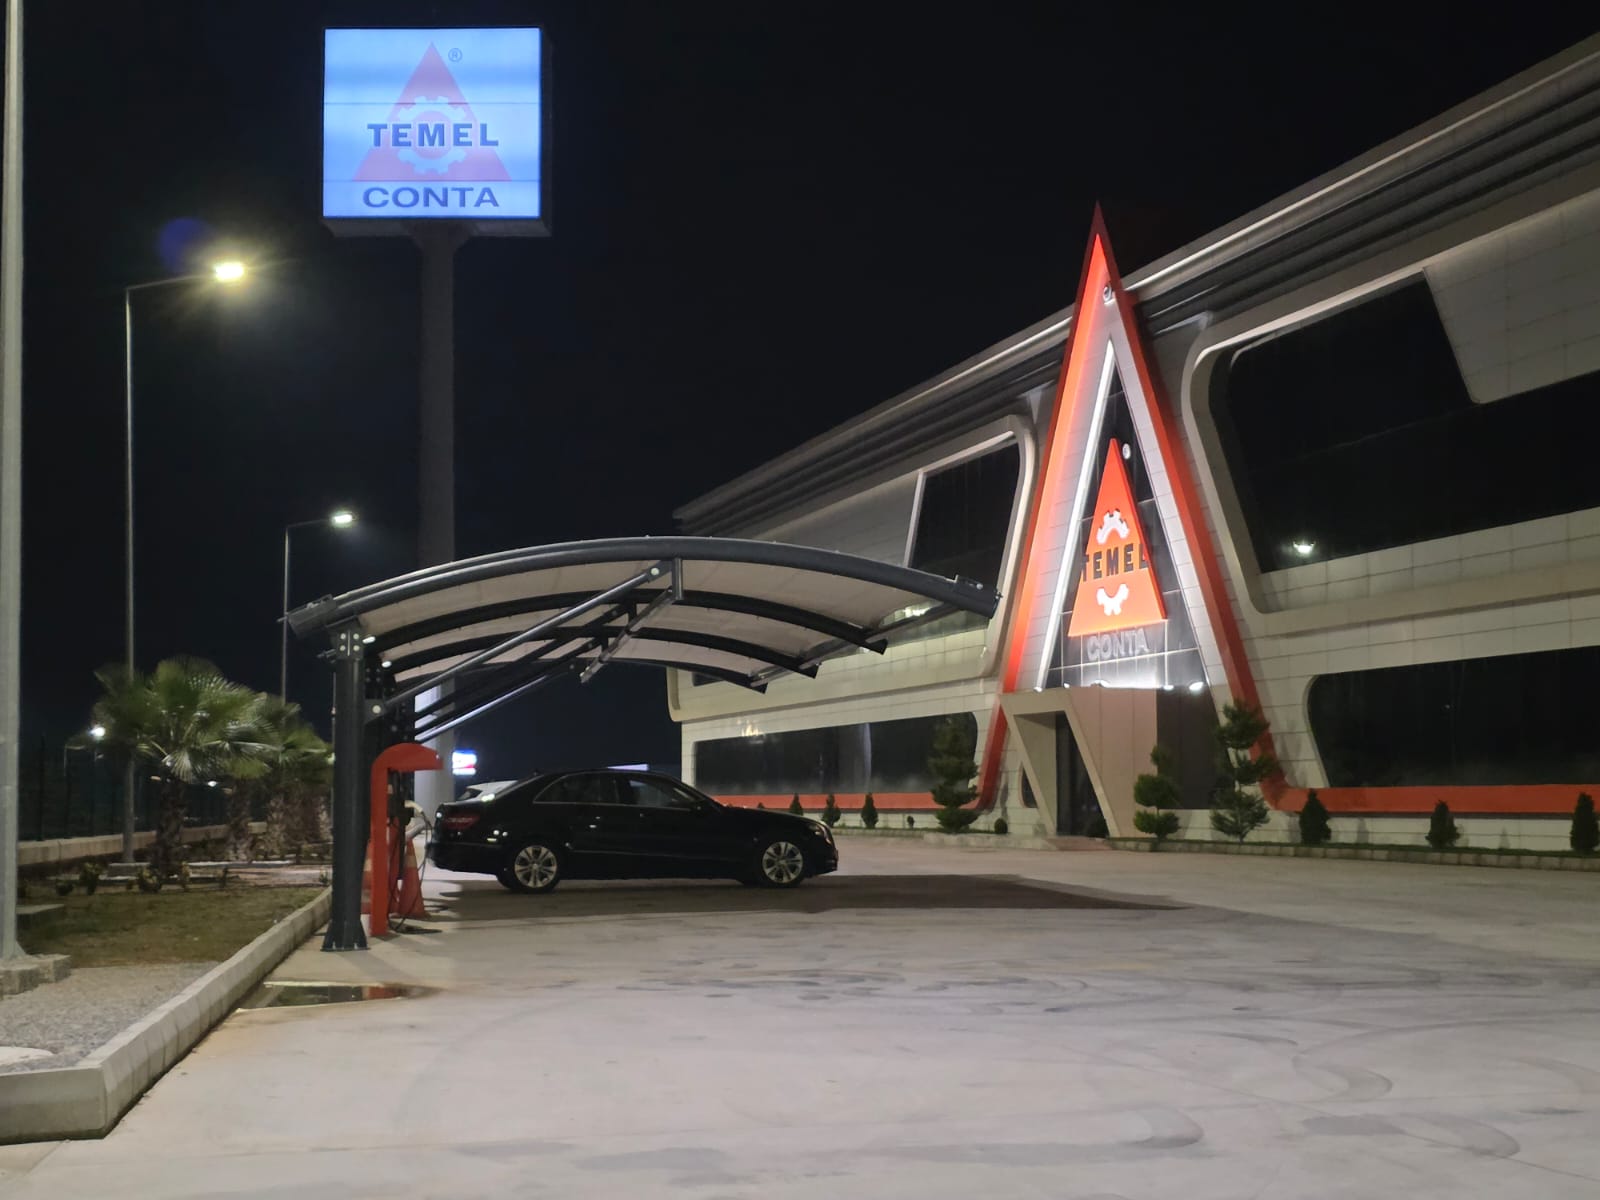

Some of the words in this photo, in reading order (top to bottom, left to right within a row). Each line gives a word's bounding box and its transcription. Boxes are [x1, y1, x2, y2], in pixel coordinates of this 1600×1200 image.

[366, 123, 499, 147] TEMEL
[363, 186, 500, 208] CONTA
[1087, 628, 1149, 661] CONTA
